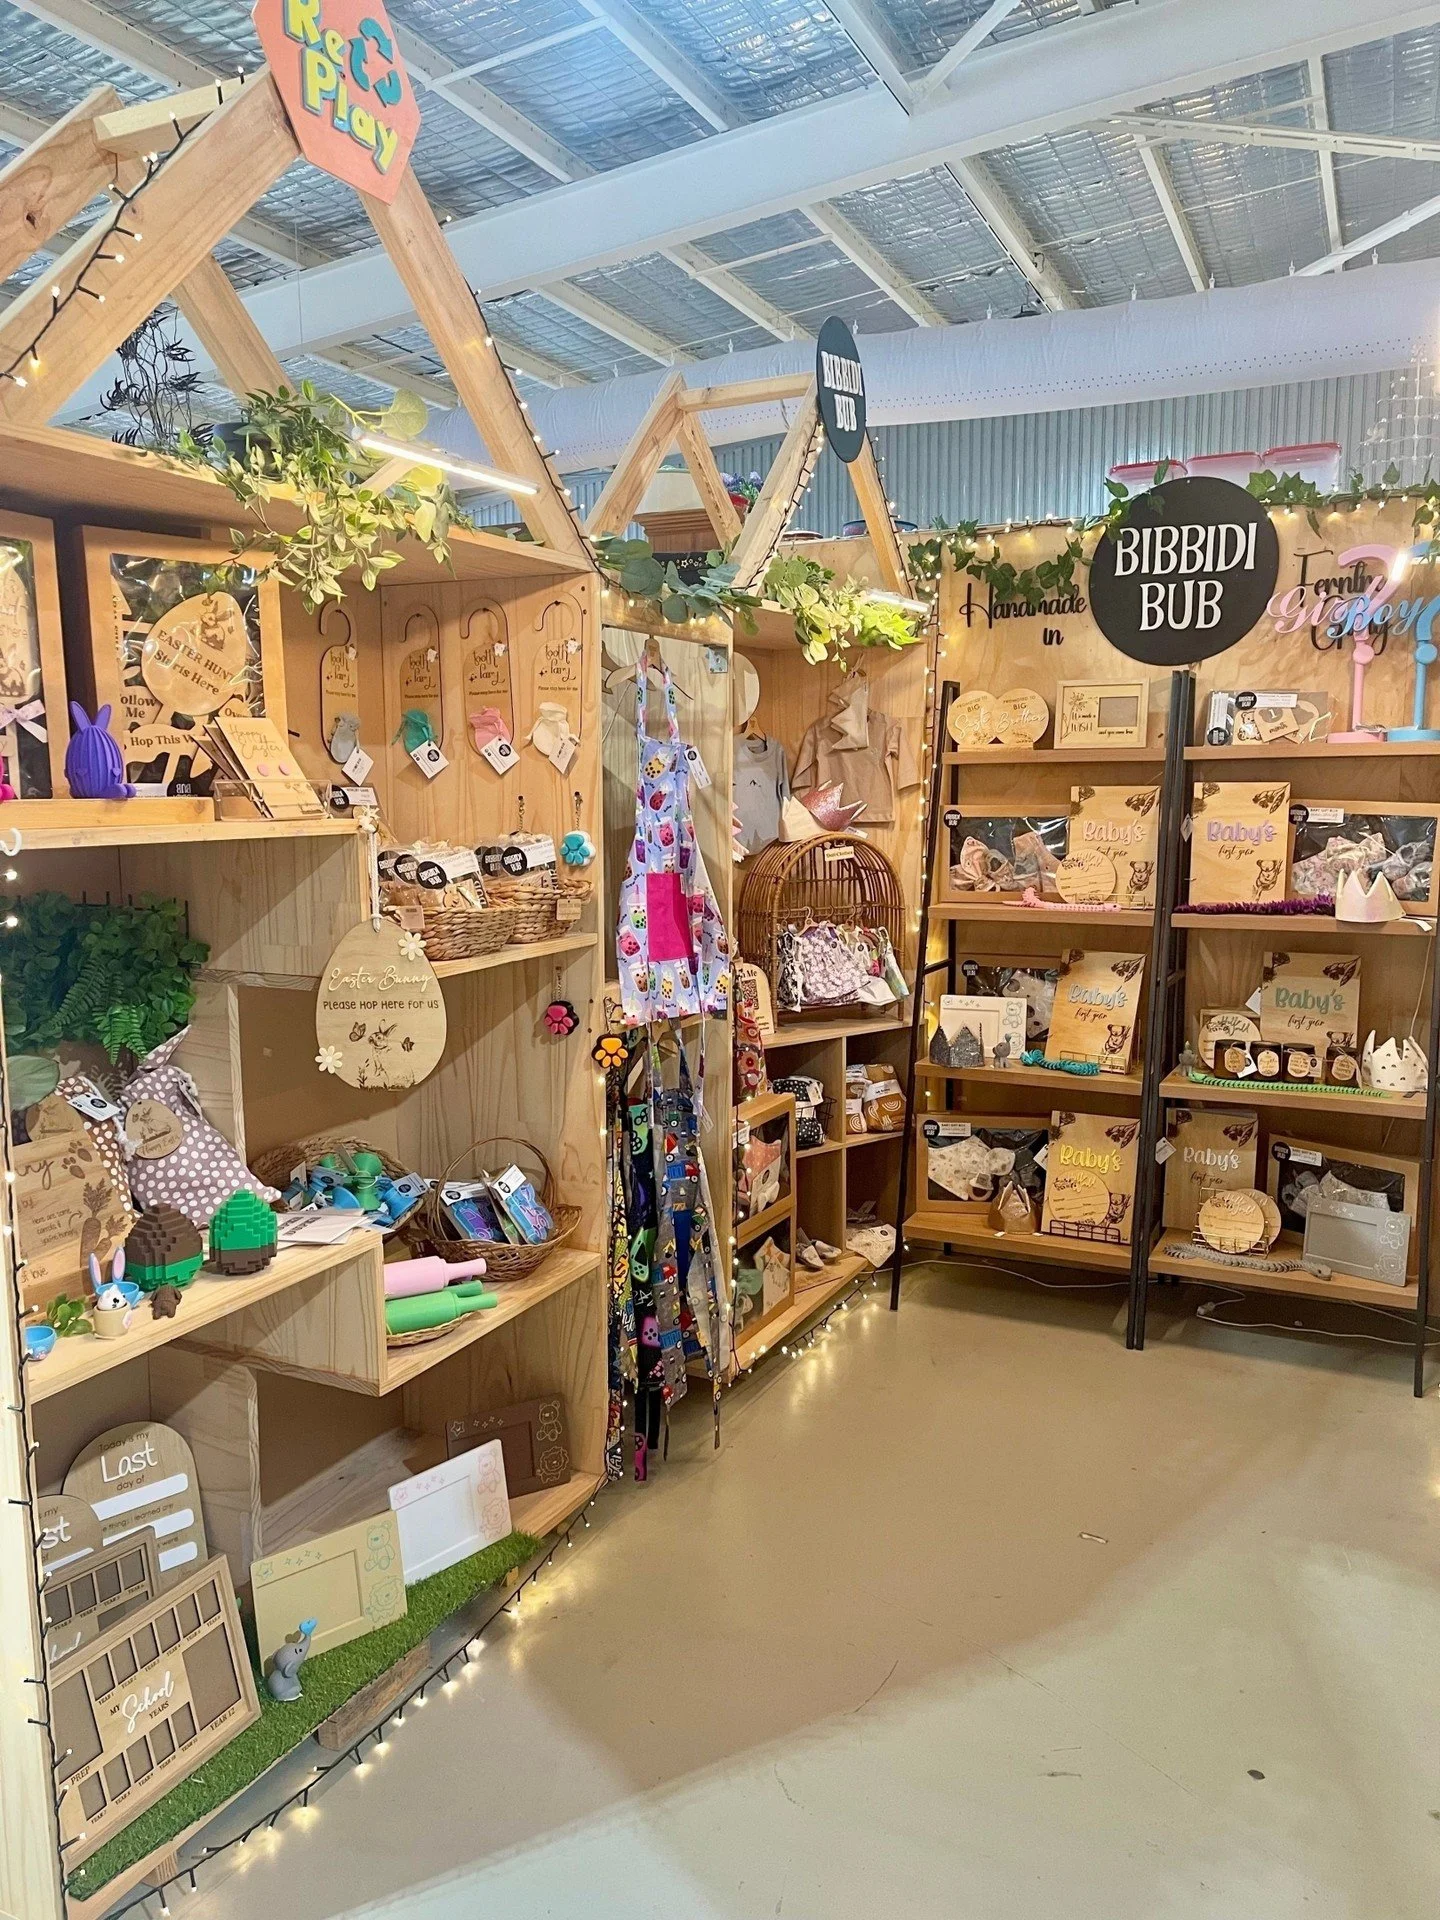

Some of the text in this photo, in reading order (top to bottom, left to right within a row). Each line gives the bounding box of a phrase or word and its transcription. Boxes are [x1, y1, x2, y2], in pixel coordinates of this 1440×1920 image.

[284, 0, 346, 68] Re
[302, 47, 398, 175] Play
[821, 351, 863, 396] BIBBIDI
[834, 394, 857, 431] BUB
[1114, 523, 1257, 576] BIBBIDI
[1139, 580, 1223, 631] BUB
[1327, 593, 1424, 639] Boy
[1043, 628, 1064, 645] in
[157, 630, 203, 664] EASTER
[191, 672, 219, 695] Here
[120, 694, 156, 707] ollow
[1013, 702, 1027, 710] BIG
[126, 707, 146, 719] Me
[967, 703, 980, 713] BIG
[1269, 709, 1278, 719] 1
[1269, 722, 1288, 734] month
[131, 737, 154, 748] Hop
[155, 735, 180, 745] This
[1083, 819, 1147, 845] Baby's
[1207, 819, 1277, 846] Baby's
[1218, 843, 1255, 860] first year
[328, 965, 433, 992] Easter Bunny
[1068, 983, 1129, 1011] Baby's
[1275, 987, 1346, 1015] Baby's
[1092, 1012, 1107, 1023] year
[1287, 1013, 1325, 1031] first year
[1060, 1144, 1124, 1174] Baby's
[1183, 1146, 1241, 1172] Baby's
[32, 1266, 49, 1280] love
[136, 1430, 150, 1441] my
[101, 1441, 158, 1482] Last
[116, 1474, 145, 1491] day of
[44, 1506, 58, 1518] my
[128, 1586, 140, 1595] YEAR
[104, 1598, 116, 1607] YEAR
[80, 1609, 93, 1619] YEAR
[207, 1618, 217, 1627] YEAR
[186, 1632, 197, 1642] YEAR
[167, 1646, 177, 1657] YEAR
[144, 1662, 156, 1672] YEAR
[121, 1677, 133, 1689] YEAR
[99, 1695, 110, 1706] YEAR
[121, 1671, 175, 1734] School
[110, 1703, 121, 1716] MY
[148, 1701, 170, 1719] YEARS
[209, 1708, 236, 1731] YEAR 12
[182, 1743, 193, 1753] YEAR
[159, 1760, 171, 1770] YEAR
[71, 1766, 90, 1786] PREP
[139, 1776, 150, 1787] YEAR
[115, 1794, 127, 1806] YEAR
[91, 1814, 103, 1825] YEAR
